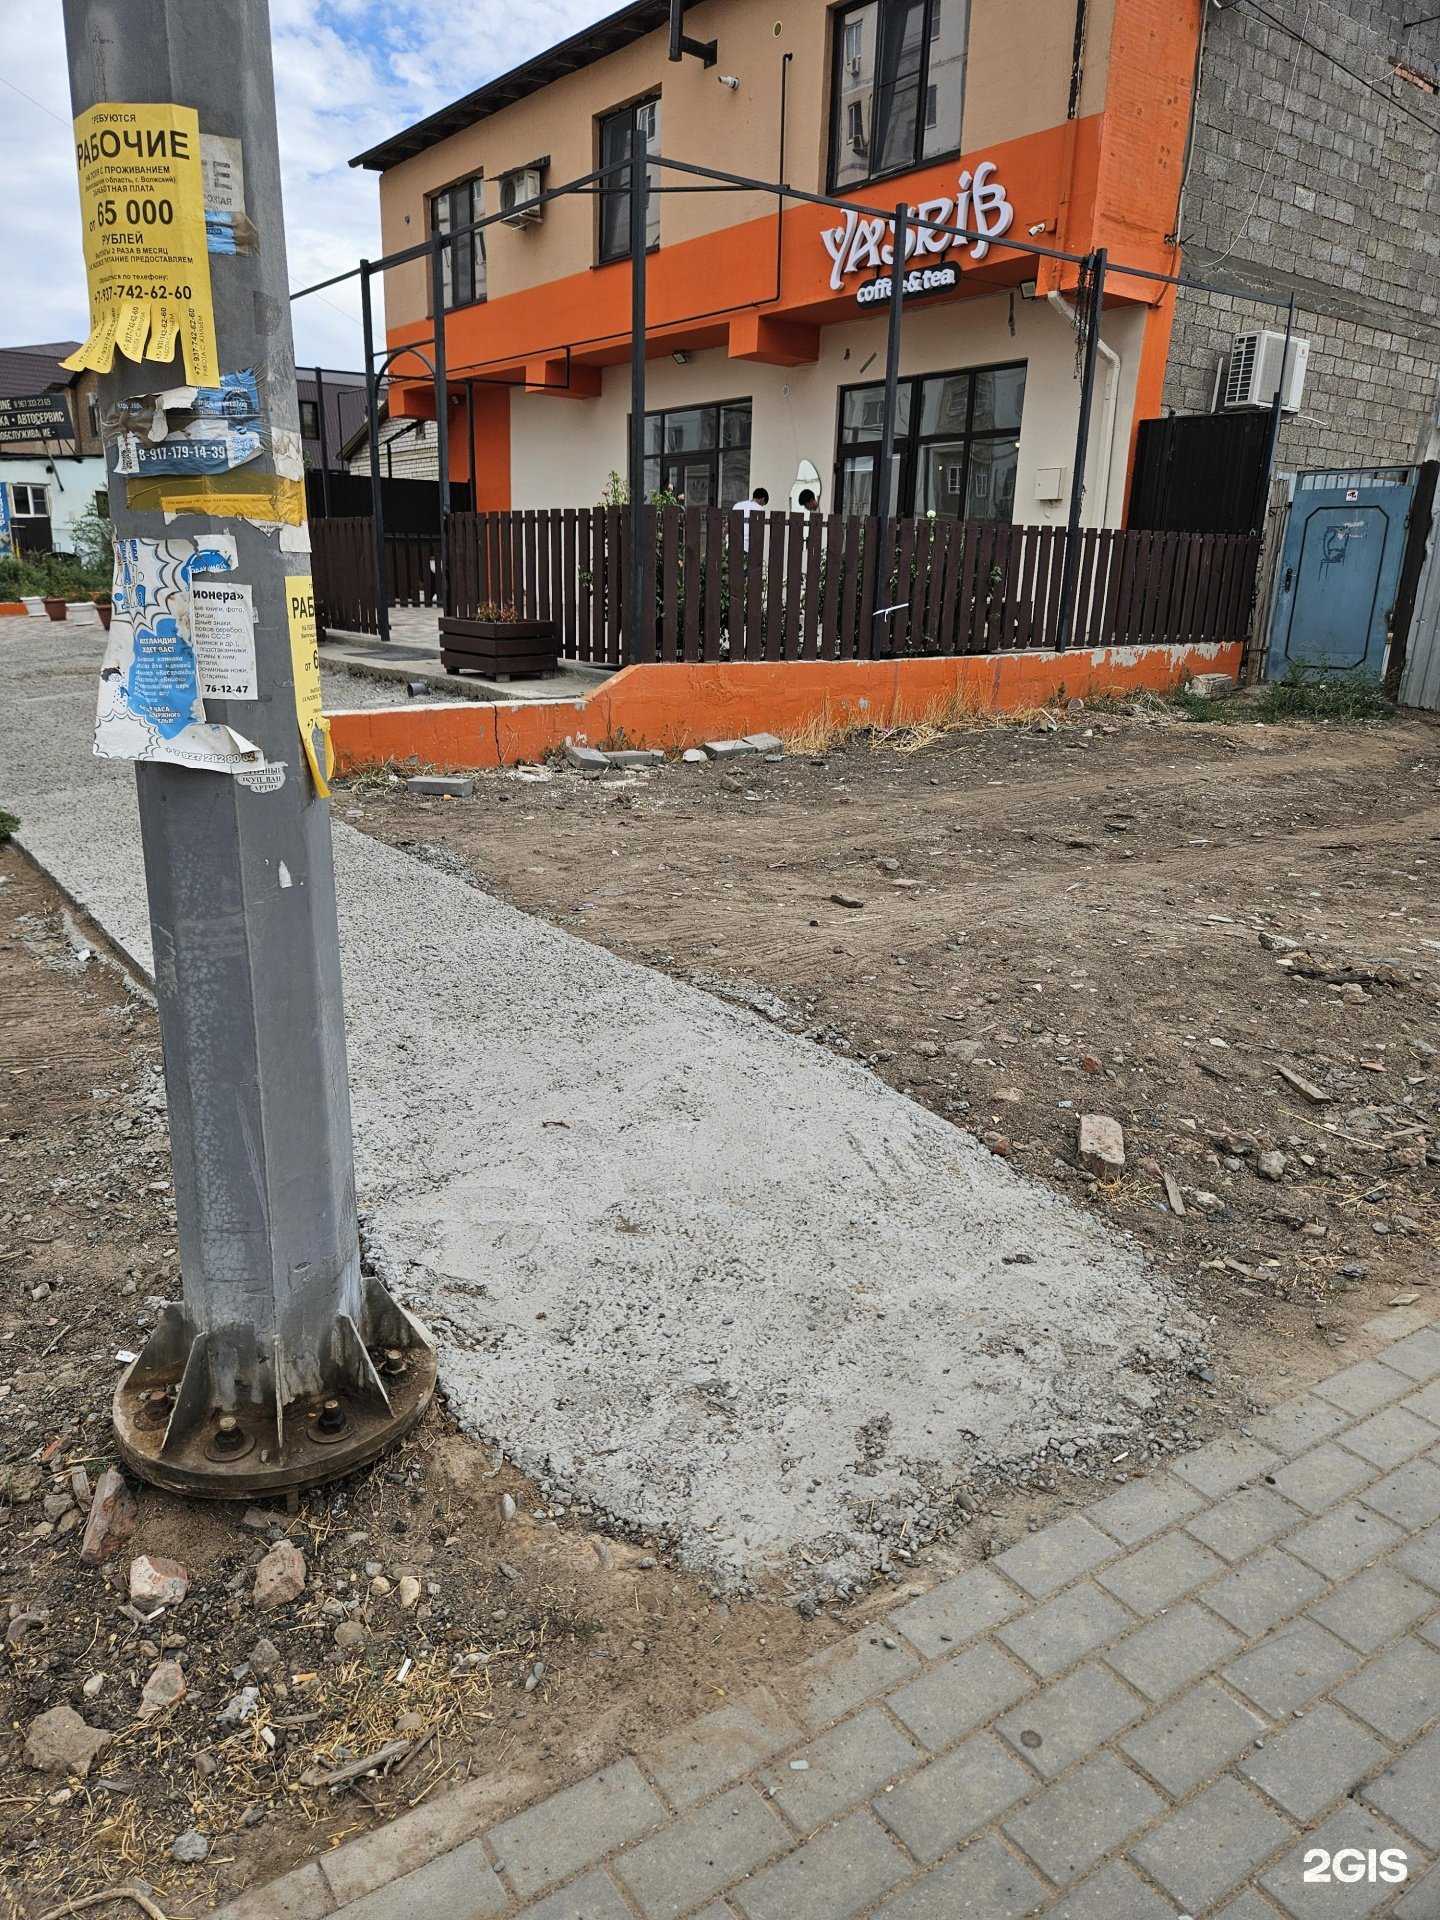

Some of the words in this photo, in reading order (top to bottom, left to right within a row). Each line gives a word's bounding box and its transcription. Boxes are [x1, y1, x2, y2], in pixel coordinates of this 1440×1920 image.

[76, 129, 190, 170] РАБОЧИЕ
[104, 166, 170, 174] ПРОЖИВАНИЕМ
[130, 184, 155, 193] ПЛАТА
[97, 200, 117, 226] 65
[126, 199, 173, 225] 000
[102, 231, 144, 246] РУБЛЕЙ
[142, 248, 168, 256] МЕСЯЦ
[130, 256, 194, 265] ПРЕДОСТАВЛЯЕМ
[17, 411, 65, 426] АВТОСЕРВИС
[138, 445, 226, 462] 8-917-179-14-39
[205, 684, 248, 694] 76-12-47
